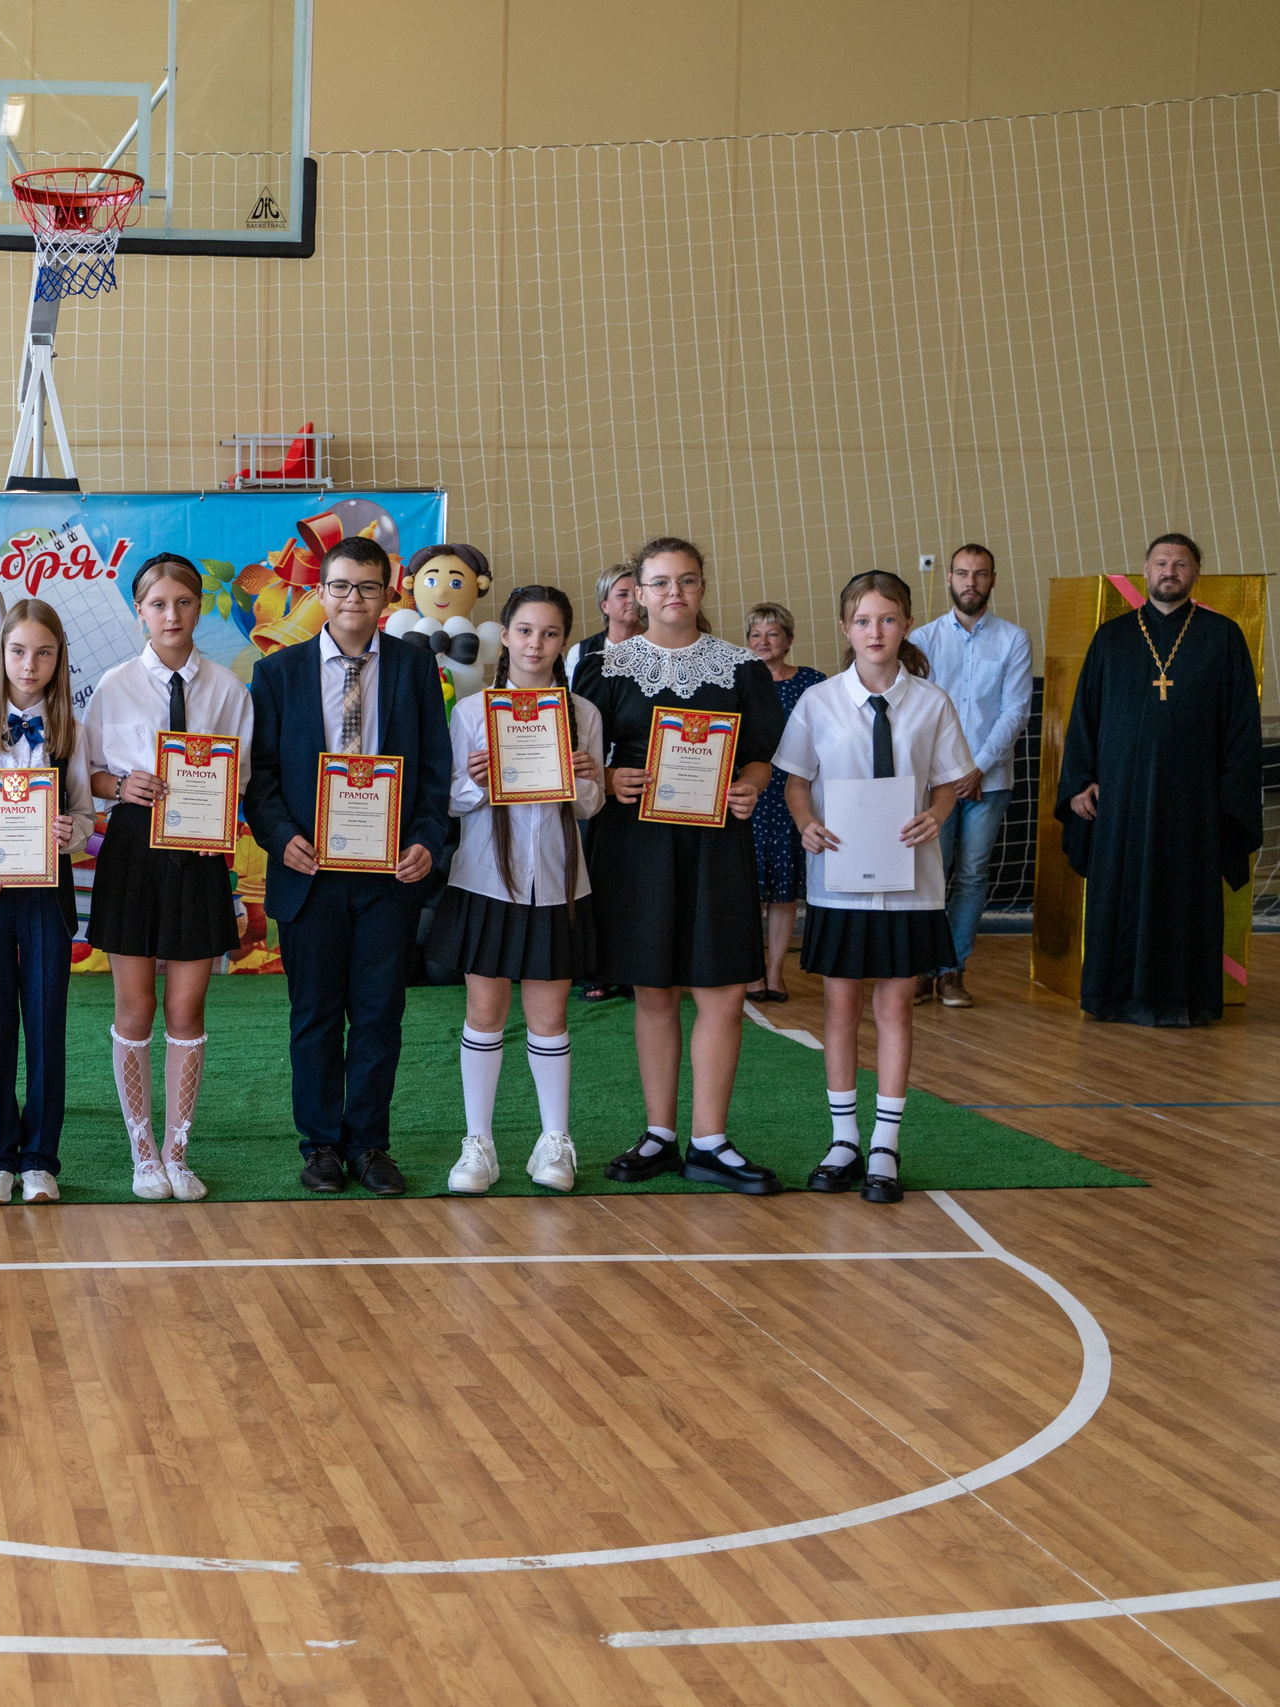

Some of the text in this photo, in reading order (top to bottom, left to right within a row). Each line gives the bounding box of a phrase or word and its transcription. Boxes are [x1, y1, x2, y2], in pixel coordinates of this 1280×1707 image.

[507, 725, 548, 733] ГРАМОТА
[671, 745, 713, 756] ГРАМОТА
[177, 769, 217, 779] ГРАМОТА
[339, 791, 380, 800] ГРАМОТА
